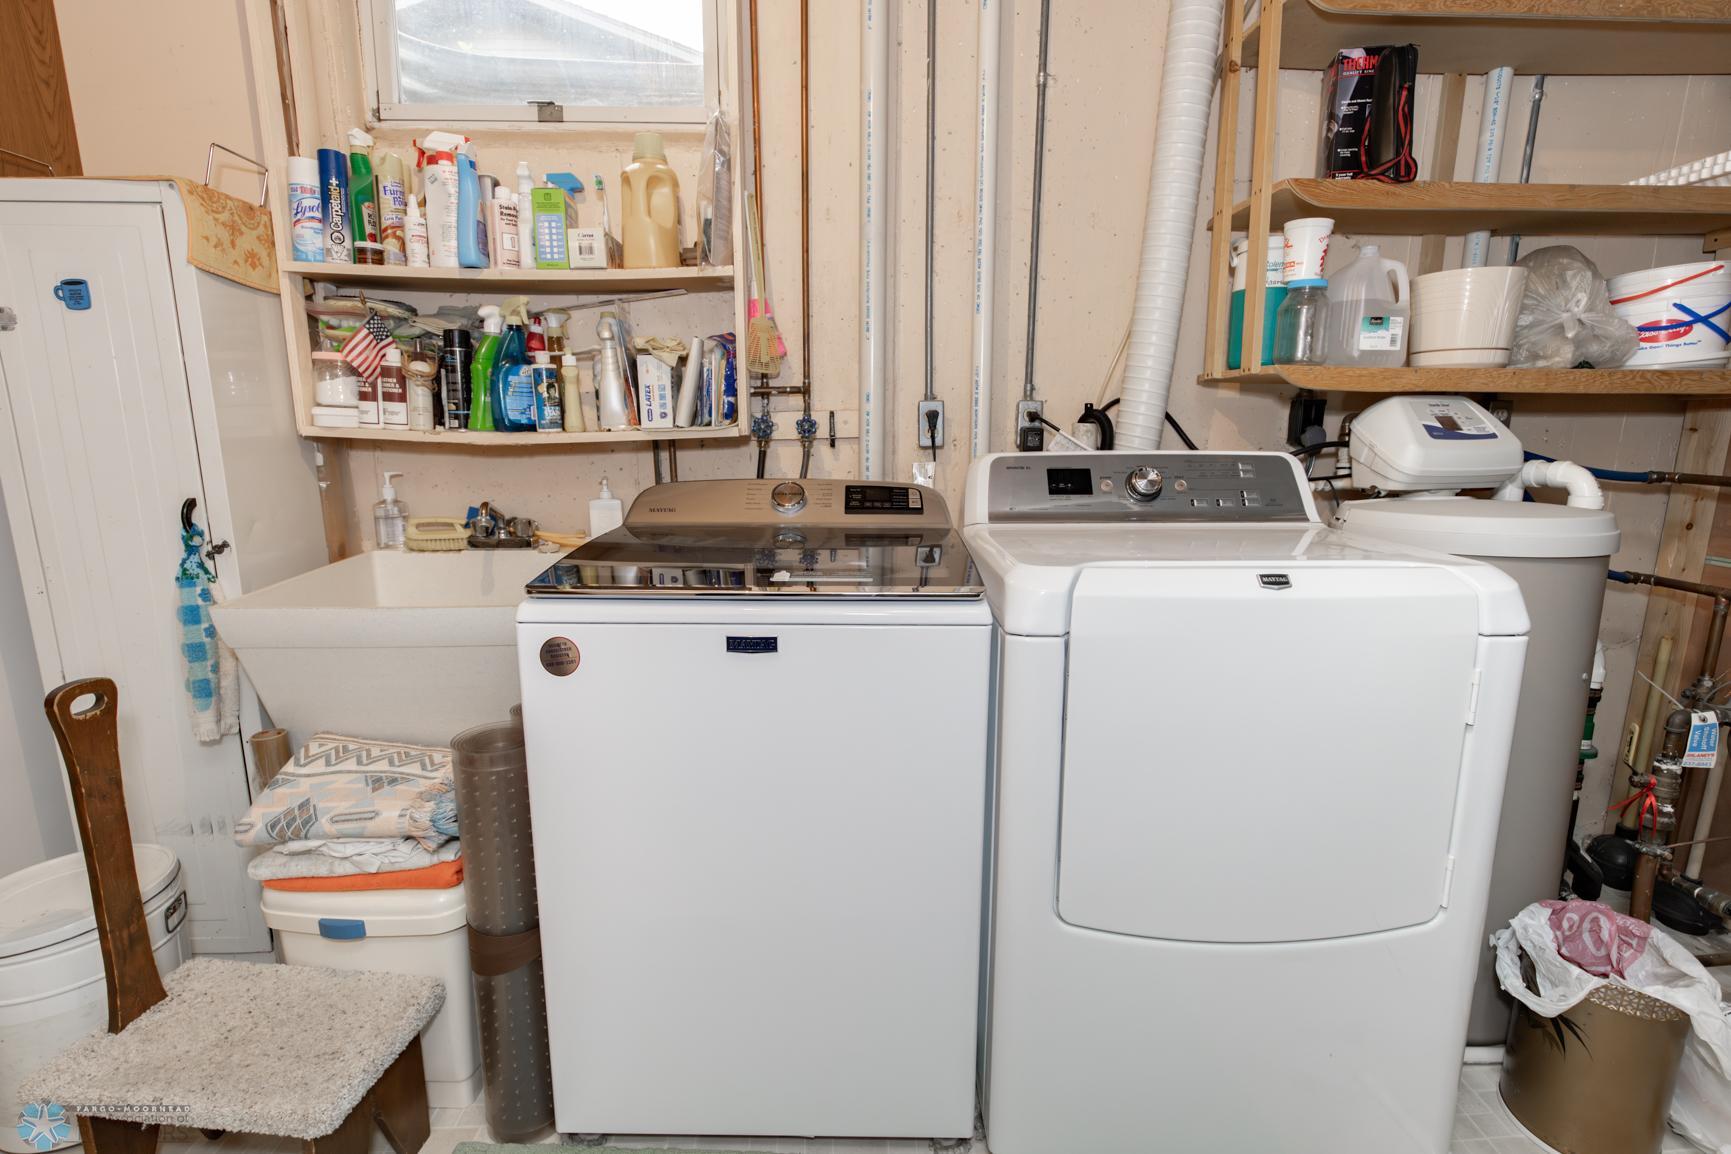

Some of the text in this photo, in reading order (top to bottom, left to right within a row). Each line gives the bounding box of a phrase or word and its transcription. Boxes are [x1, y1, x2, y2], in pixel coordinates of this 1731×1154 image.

[293, 199, 320, 216] Lysol
[328, 175, 345, 231] Carpetaid+
[1692, 730, 1702, 747] Valve
